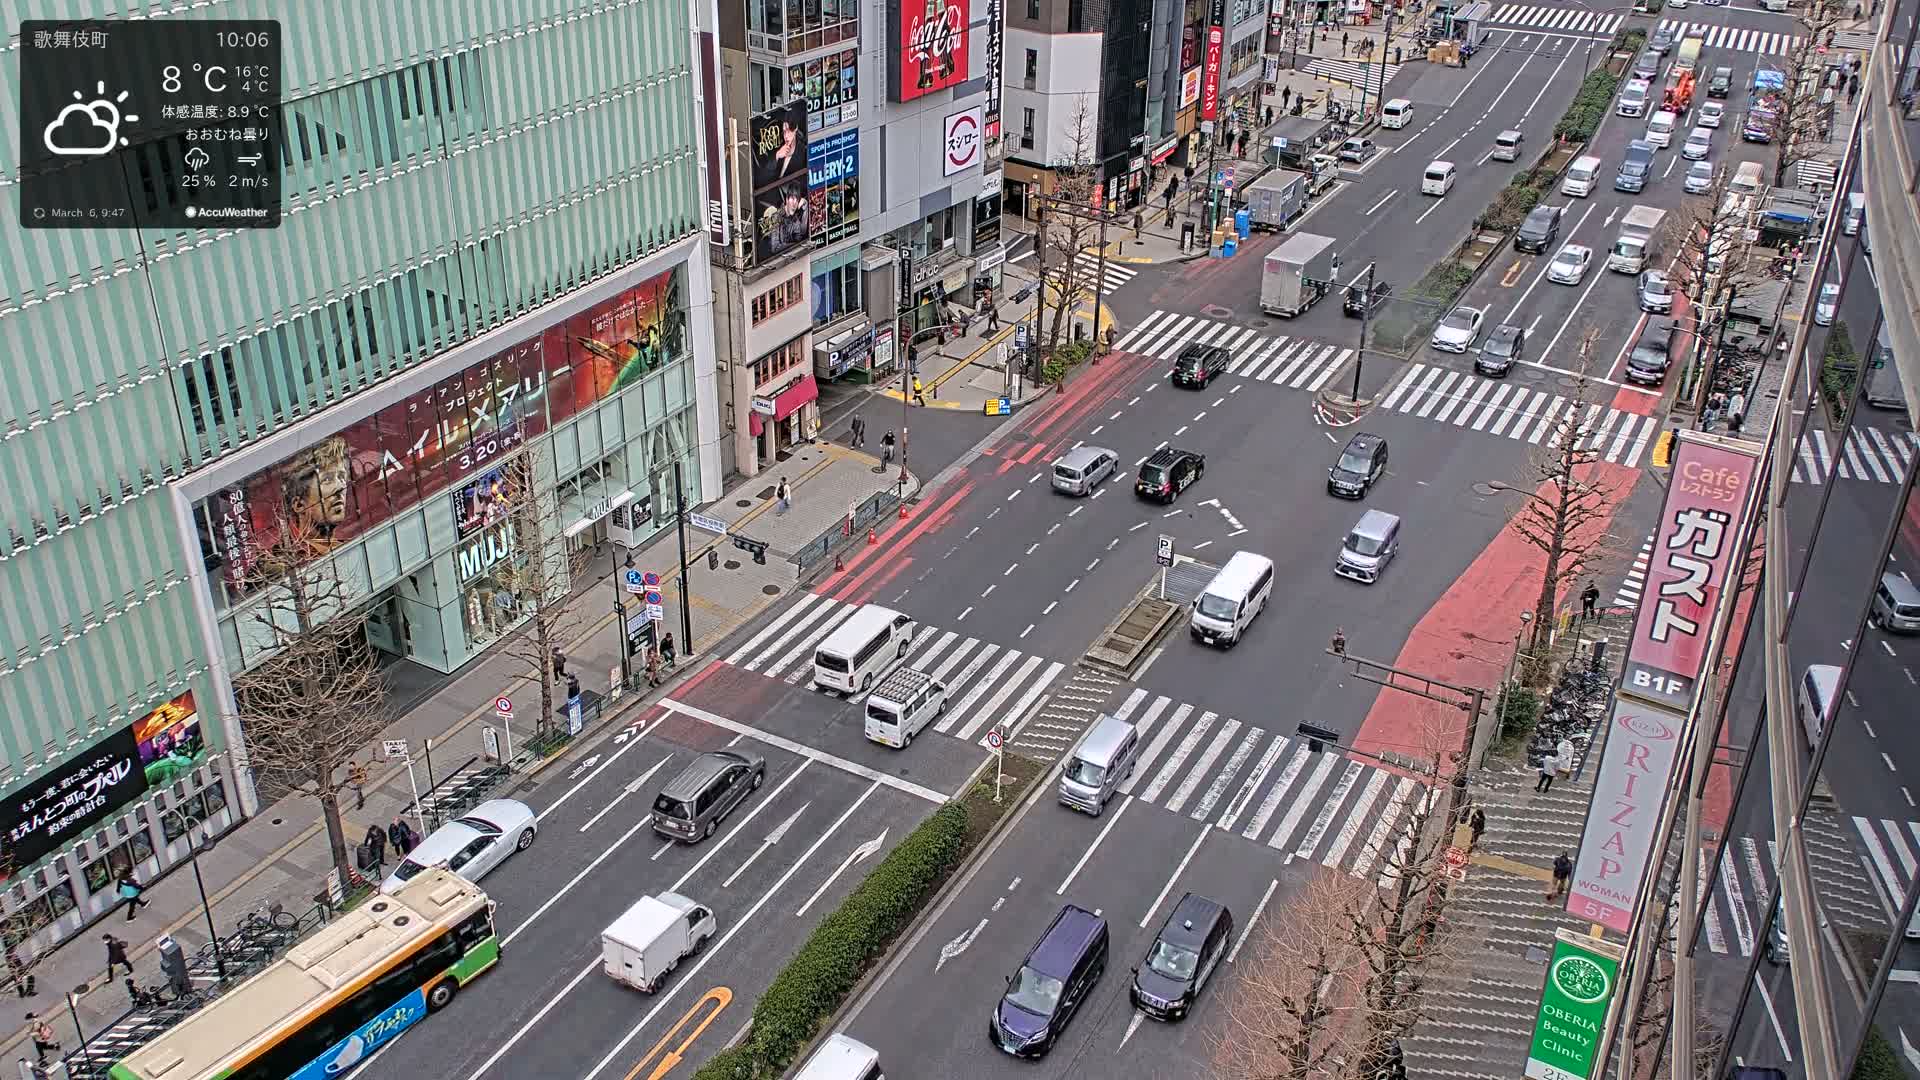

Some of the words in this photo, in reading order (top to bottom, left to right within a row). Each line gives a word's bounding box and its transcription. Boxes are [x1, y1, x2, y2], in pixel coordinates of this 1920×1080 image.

[1205, 46, 1219, 111] バーガーキング
[810, 140, 831, 154] SPORTS
[831, 137, 843, 149] PRO
[843, 133, 856, 145] SHOP
[948, 132, 979, 151] スシロー
[808, 155, 854, 186] ALLERY-2
[709, 200, 722, 233] MUJI
[829, 223, 858, 241] BASKETBALL
[902, 249, 909, 259] P
[1017, 326, 1026, 336] P
[829, 351, 839, 368] P
[409, 341, 541, 413] ライアン・ゴズリング
[445, 377, 503, 413] プロジェクト
[999, 399, 1006, 409] P
[459, 440, 498, 471] 3.20
[1682, 461, 1741, 488] Café
[1679, 480, 1737, 502] レストラン
[592, 496, 614, 520] MUJI
[459, 521, 515, 581] MUJI
[1160, 539, 1169, 549] P
[1650, 508, 1731, 643] ガスト
[1632, 669, 1684, 697] B1F
[21, 753, 113, 813] もう一度、君に会いたい
[20, 757, 131, 838] えんとつ町のプペル
[1597, 741, 1652, 881] RIZAP
[1578, 879, 1632, 905] WOMAN
[1584, 901, 1614, 920] 5F
[1559, 970, 1600, 991] OBERIA
[1543, 1004, 1598, 1033] OBERIA
[1543, 1020, 1590, 1047] Beauty
[1542, 1039, 1584, 1062] Clinic
